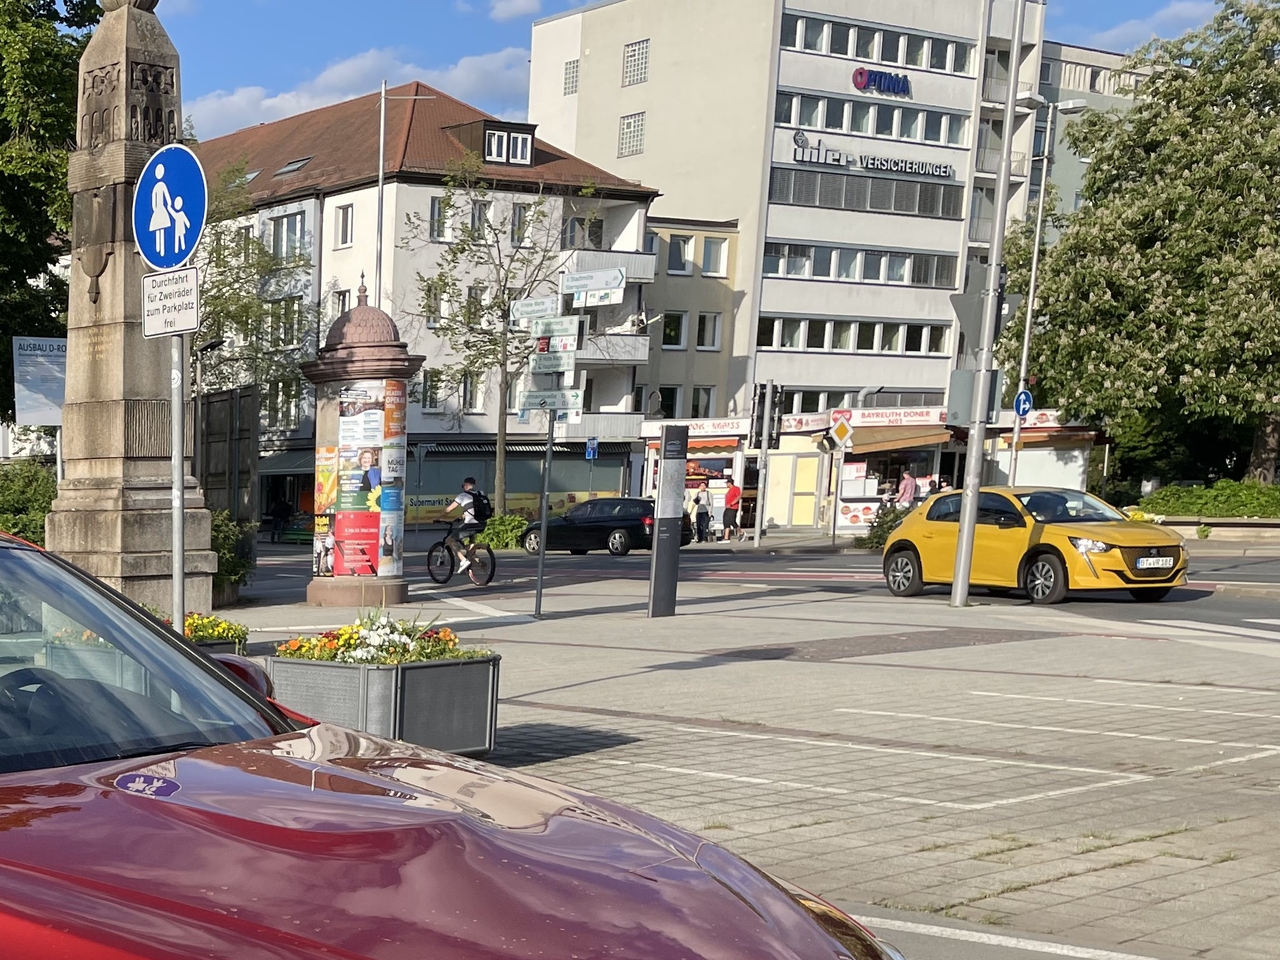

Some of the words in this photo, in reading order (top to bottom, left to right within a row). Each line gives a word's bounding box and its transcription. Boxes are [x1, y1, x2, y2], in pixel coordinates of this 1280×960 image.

[852, 67, 910, 95] OPTIMA
[860, 155, 952, 177] VERSICHERUNGEN
[151, 274, 188, 289] Durchfahrt
[147, 293, 157, 303] für
[159, 288, 193, 301] Zweiräder
[146, 308, 160, 317] zum
[162, 302, 195, 314] Parkplatz
[164, 318, 176, 328] frei
[18, 343, 47, 352] AUSBAU
[861, 411, 901, 419] BAYREUTH
[409, 498, 444, 507] Supermarkt
